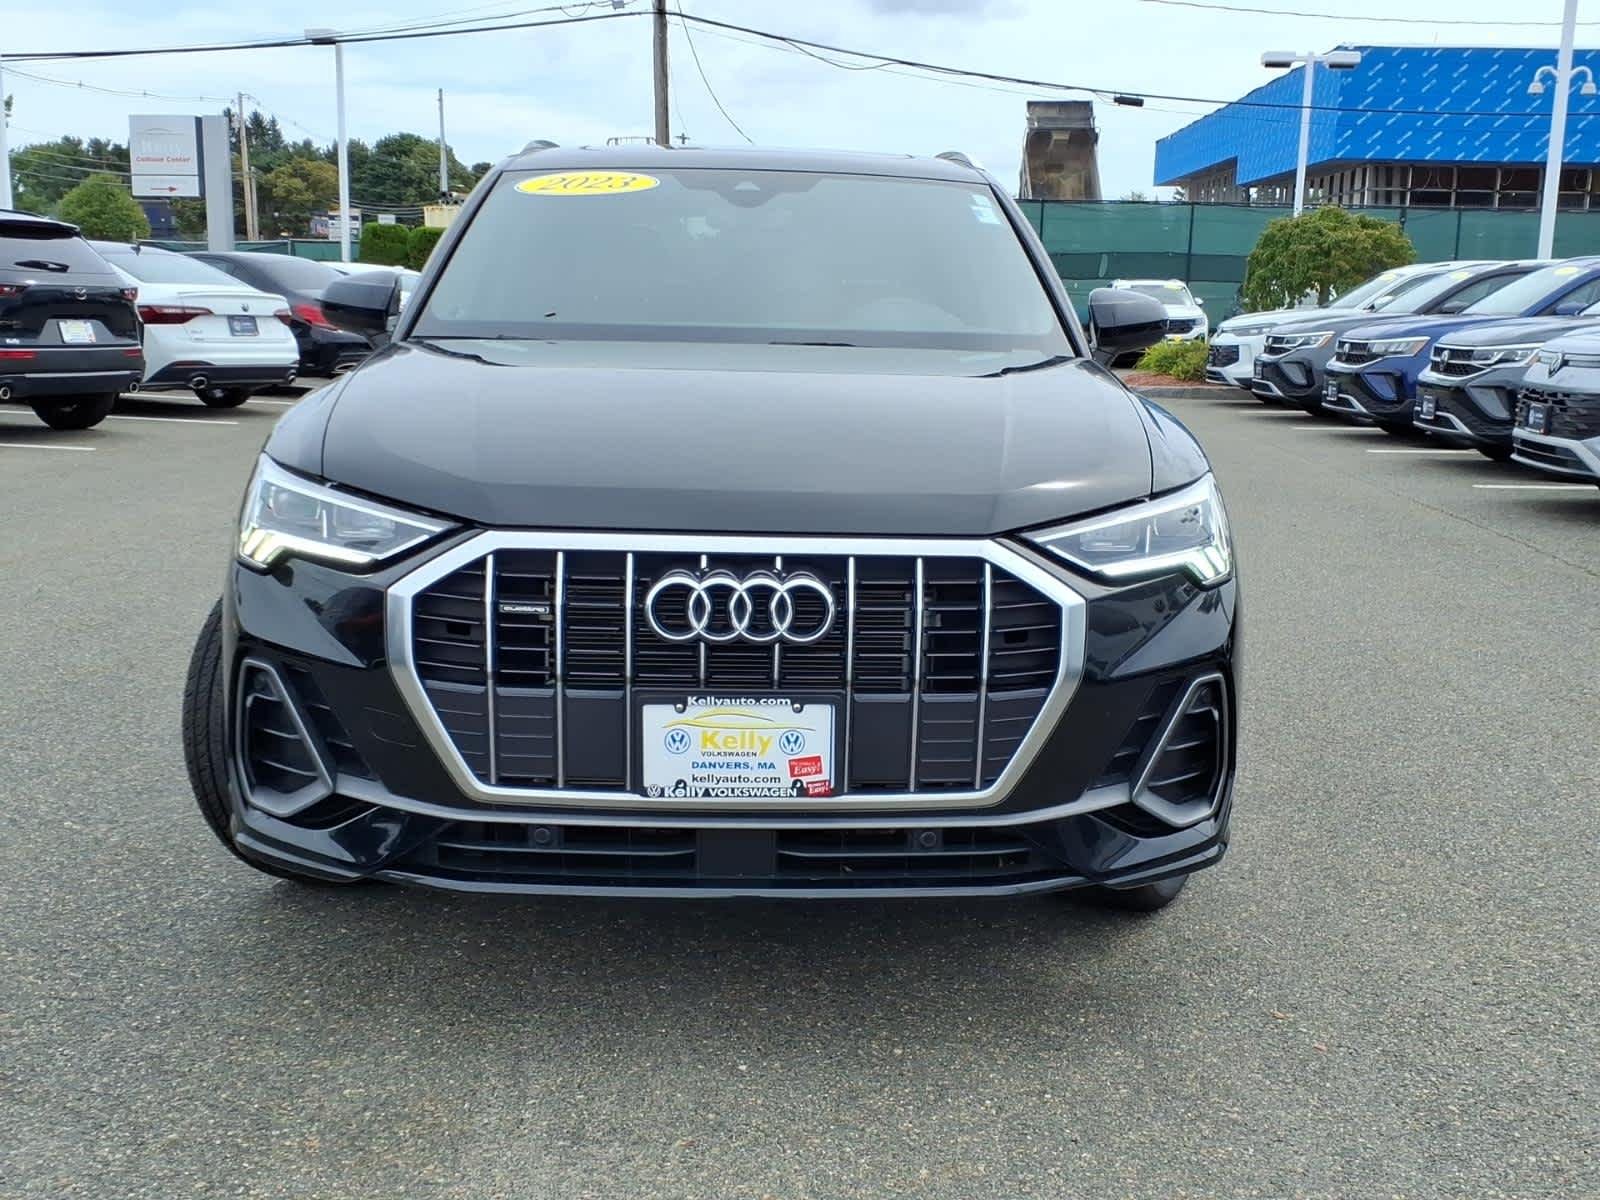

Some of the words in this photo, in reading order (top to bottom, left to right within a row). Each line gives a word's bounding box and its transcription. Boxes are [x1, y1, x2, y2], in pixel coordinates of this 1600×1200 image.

[537, 176, 638, 191] 2023
[687, 696, 791, 708] Kellyauto.com
[700, 729, 774, 755] Kelly
[691, 761, 754, 771] DANVERS,
[758, 762, 777, 770] MA
[691, 774, 782, 785] kellyauto.com
[664, 786, 706, 799] Kelly
[709, 787, 798, 797] VOLKSWAGEN
